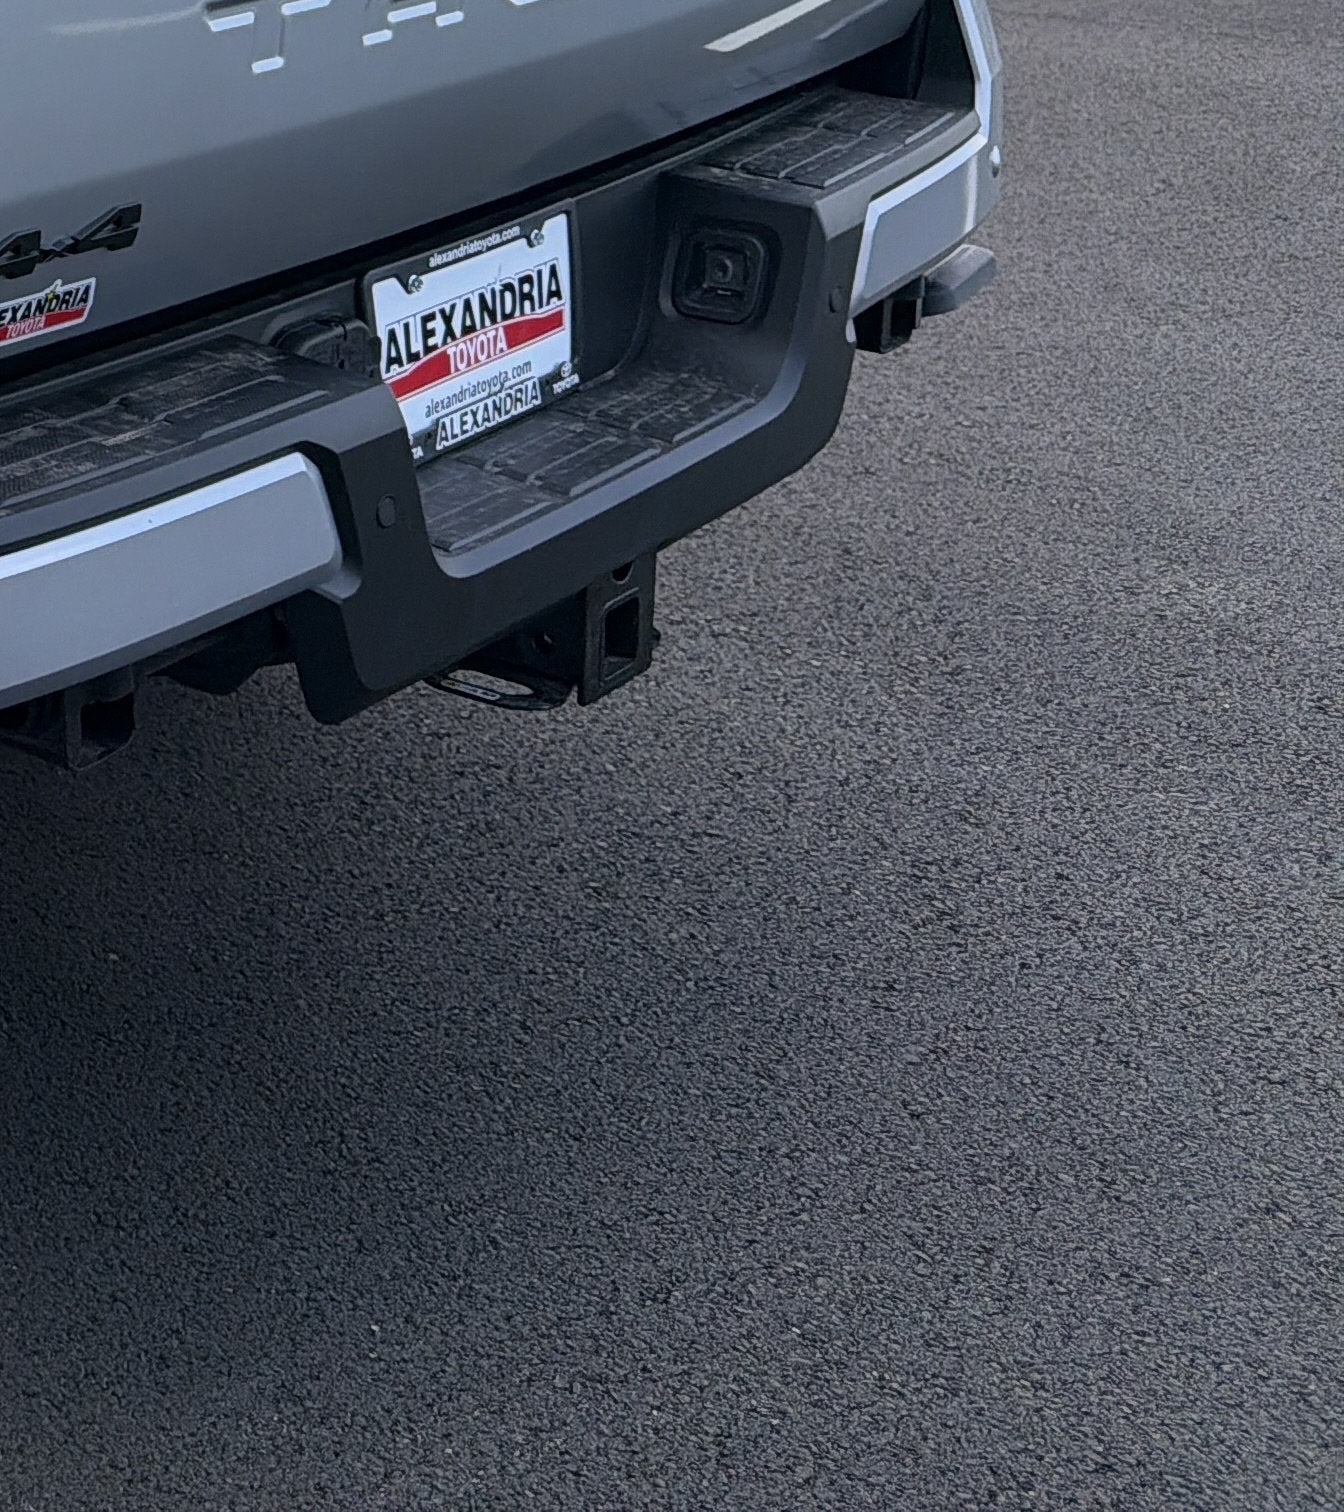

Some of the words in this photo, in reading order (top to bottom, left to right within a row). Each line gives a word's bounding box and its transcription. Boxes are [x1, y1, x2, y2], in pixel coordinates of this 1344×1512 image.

[429, 225, 521, 268] alexandriatoyota.com
[6, 316, 47, 340] TOYOTA
[383, 261, 564, 375] ALEXANDRIA
[447, 326, 509, 375] TOYOTA
[424, 360, 533, 420] alexandriatoyota.com
[436, 376, 542, 451] ALEXANDRIA
